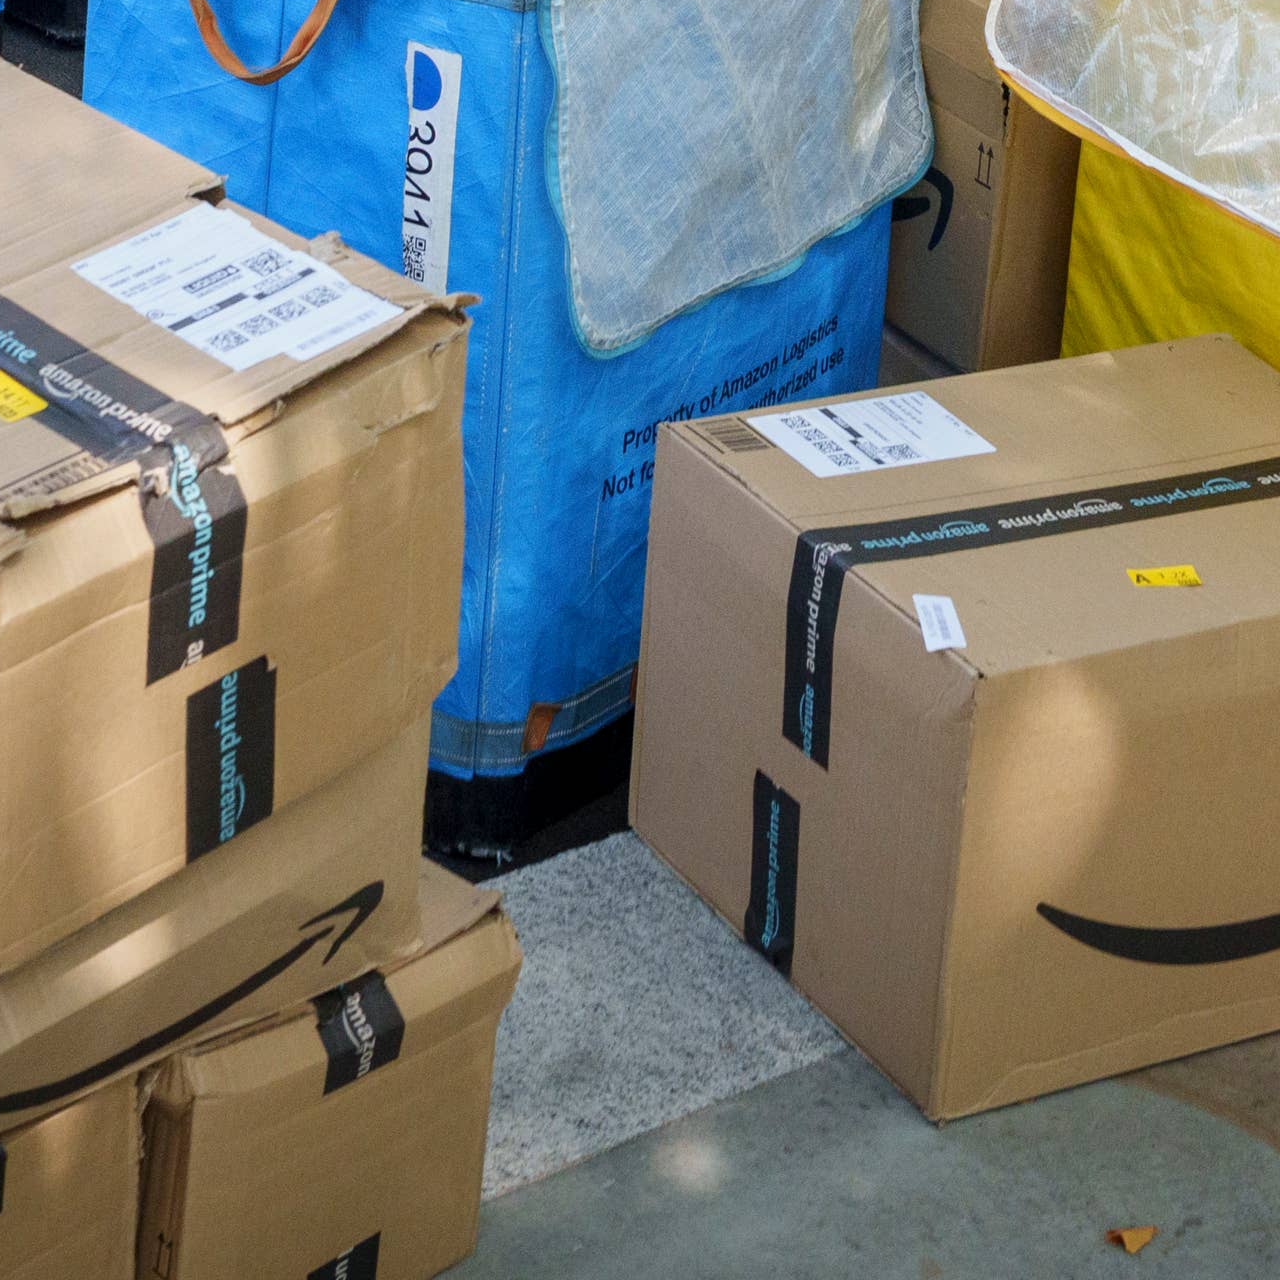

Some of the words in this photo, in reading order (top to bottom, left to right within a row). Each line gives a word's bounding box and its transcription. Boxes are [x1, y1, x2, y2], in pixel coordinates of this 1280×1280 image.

[39, 363, 113, 413] amazon
[99, 399, 173, 442] prime
[622, 401, 696, 453] Proprty
[699, 386, 719, 414] of
[720, 356, 779, 402] Amazon
[782, 314, 839, 366] Logistics
[601, 471, 636, 502] Not
[747, 360, 818, 411] uthorized
[820, 347, 845, 374] use
[172, 442, 213, 546] amazon
[997, 507, 1060, 531] prime
[1058, 500, 1124, 522] amazon
[1130, 488, 1190, 508] prime
[1189, 477, 1253, 500] amazon
[860, 529, 923, 550] prime
[921, 522, 991, 547] amazon
[188, 545, 215, 629] prime
[806, 600, 821, 674] prime
[213, 671, 242, 752] prime
[802, 683, 815, 759] amazo
[219, 750, 243, 843] amazon
[766, 799, 780, 871] prime
[761, 869, 778, 950] amazon
[345, 991, 376, 1078] amazon
